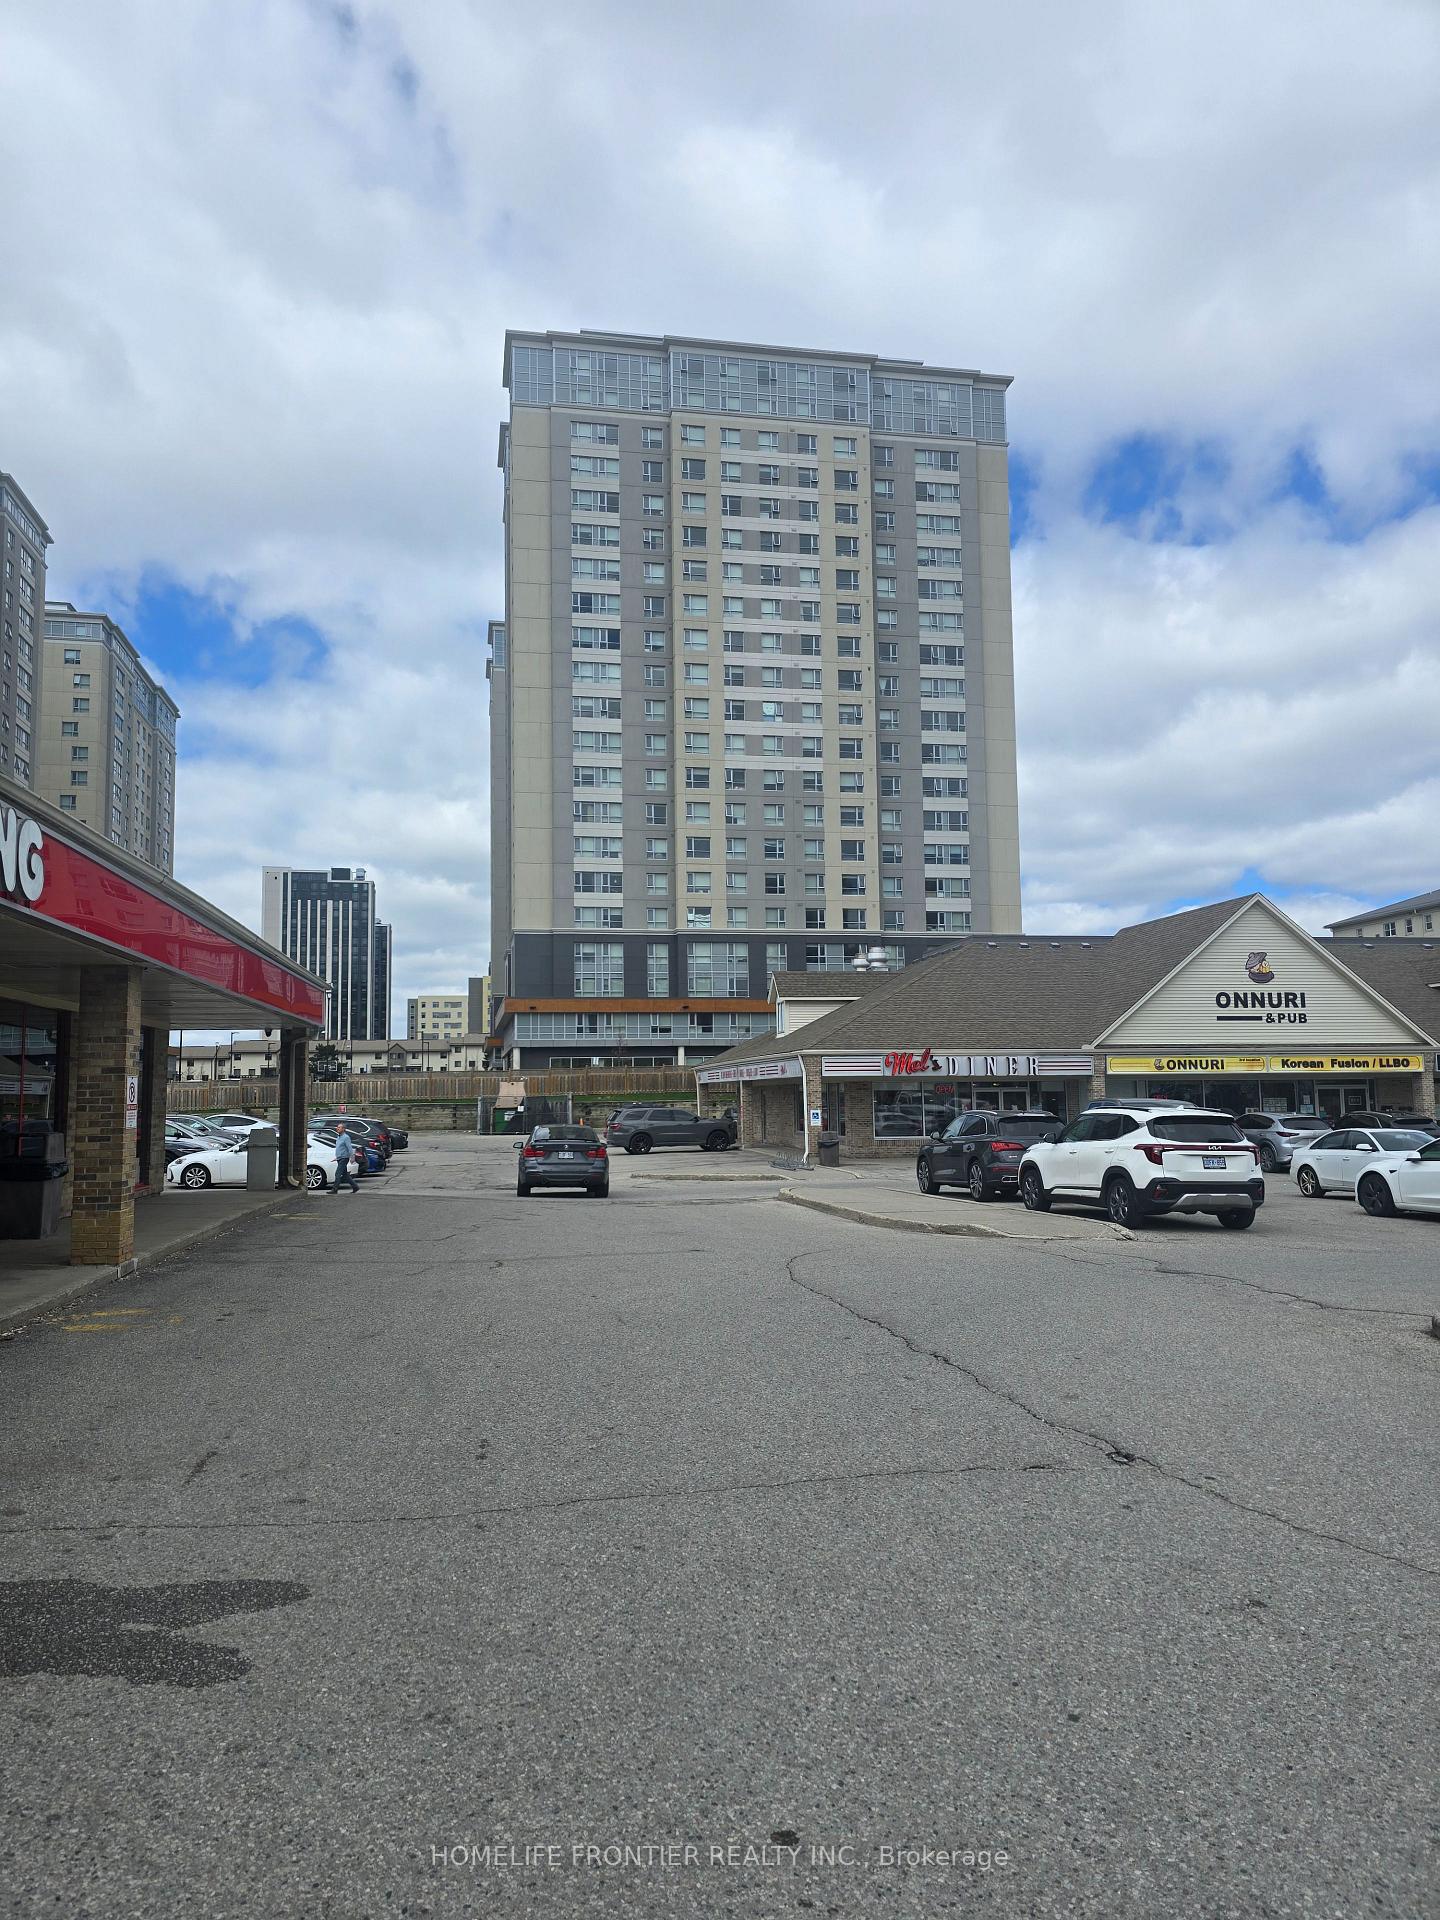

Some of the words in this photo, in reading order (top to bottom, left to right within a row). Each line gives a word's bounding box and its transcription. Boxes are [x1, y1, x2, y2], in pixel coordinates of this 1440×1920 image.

[1215, 992, 1306, 1009] ONNURI
[1265, 1012, 1308, 1024] &PUB
[885, 1048, 943, 1076] Mel's
[946, 1056, 1040, 1076] DINER
[1166, 1059, 1225, 1071] ONNURI
[1281, 1059, 1324, 1069] Korean
[1330, 1059, 1370, 1069] Fusion
[1373, 1058, 1376, 1069] /
[1379, 1058, 1410, 1068] LLBO
